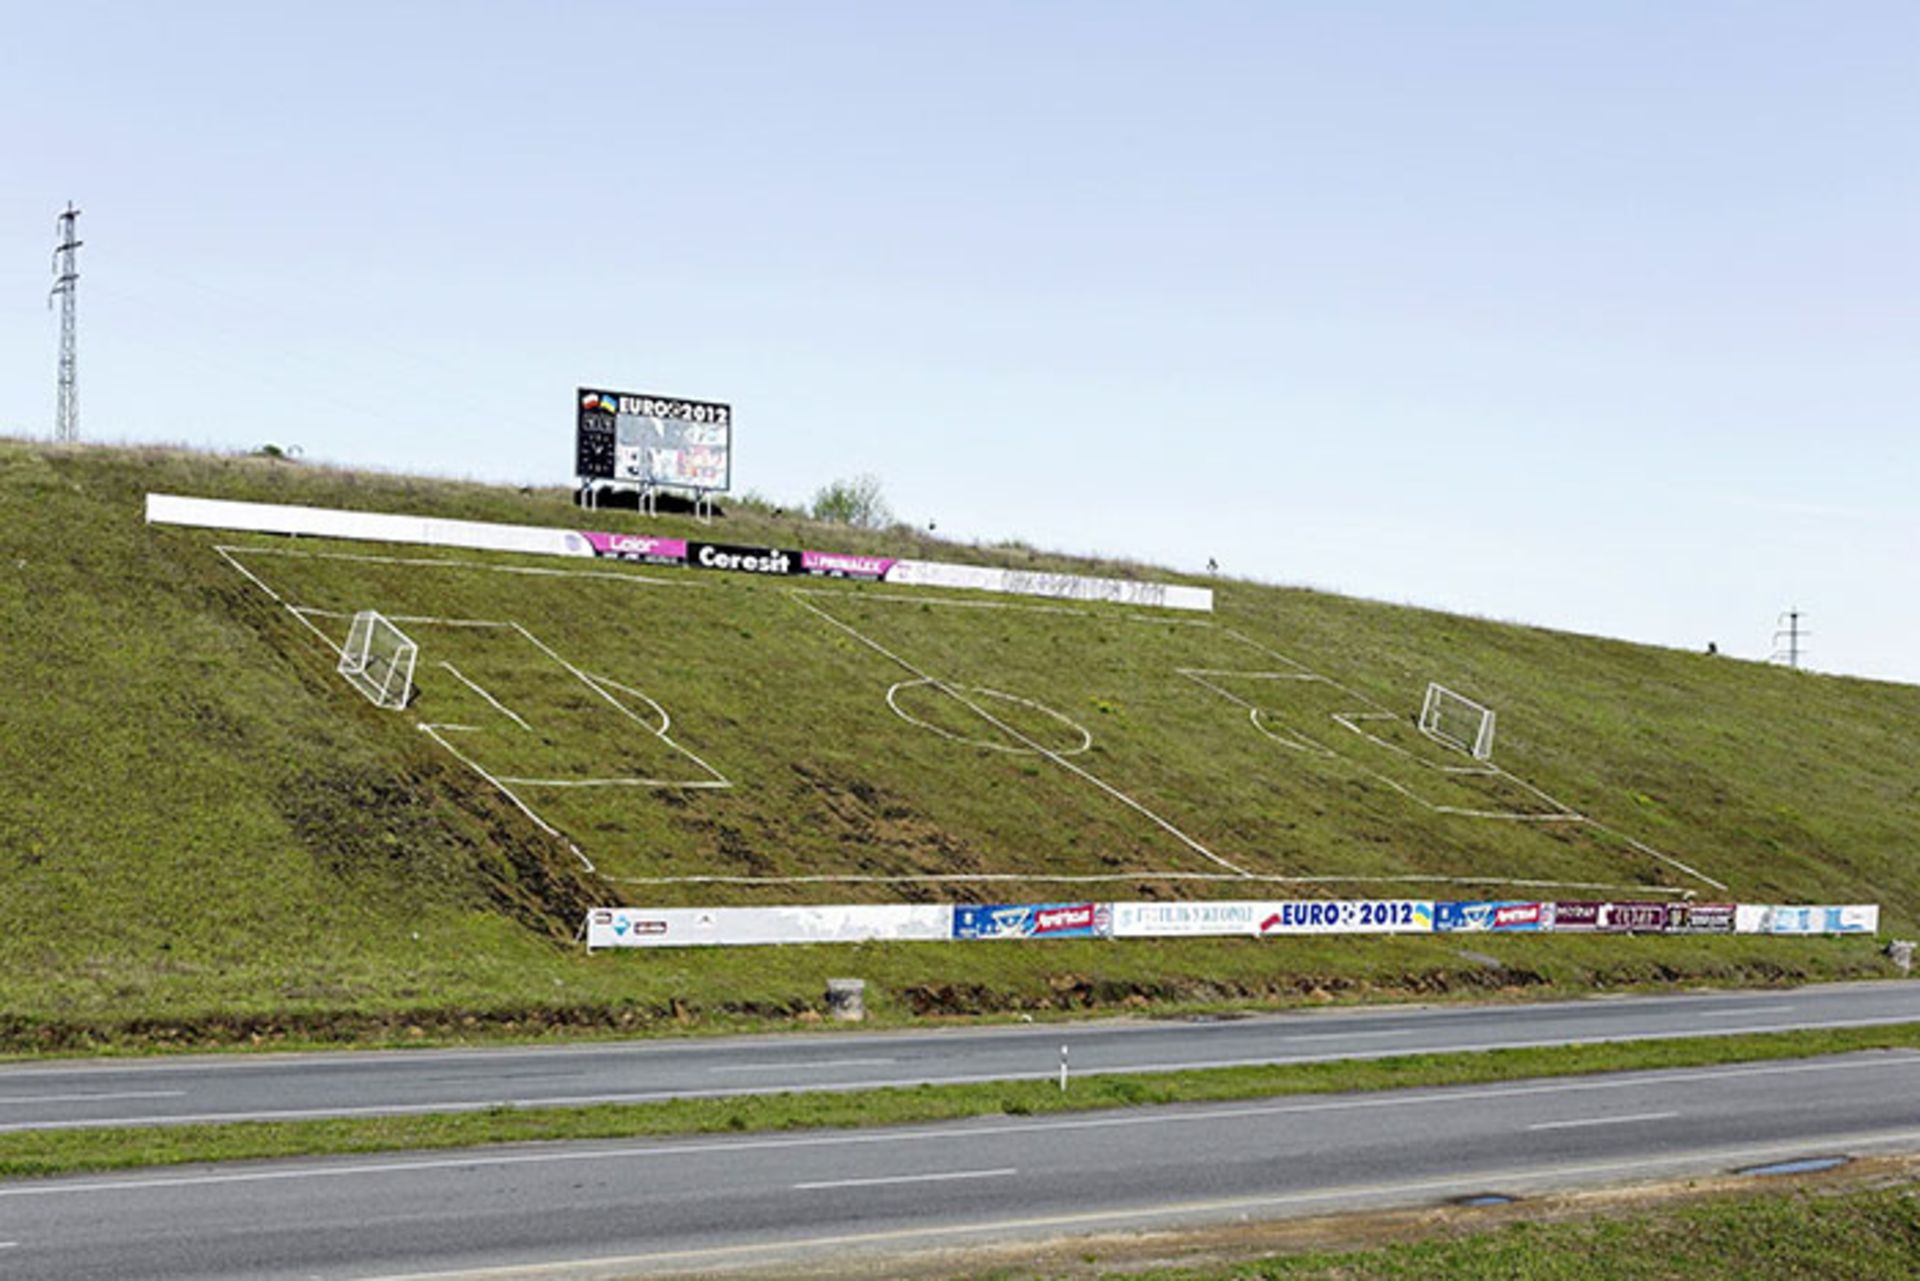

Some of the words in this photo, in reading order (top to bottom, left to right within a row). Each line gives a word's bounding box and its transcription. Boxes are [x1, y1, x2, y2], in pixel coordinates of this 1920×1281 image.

[619, 397, 669, 416] EURO
[682, 404, 728, 423] 2012
[699, 546, 791, 573] Ceresit
[1282, 904, 1340, 925] EURO
[1359, 903, 1413, 925] 2012
